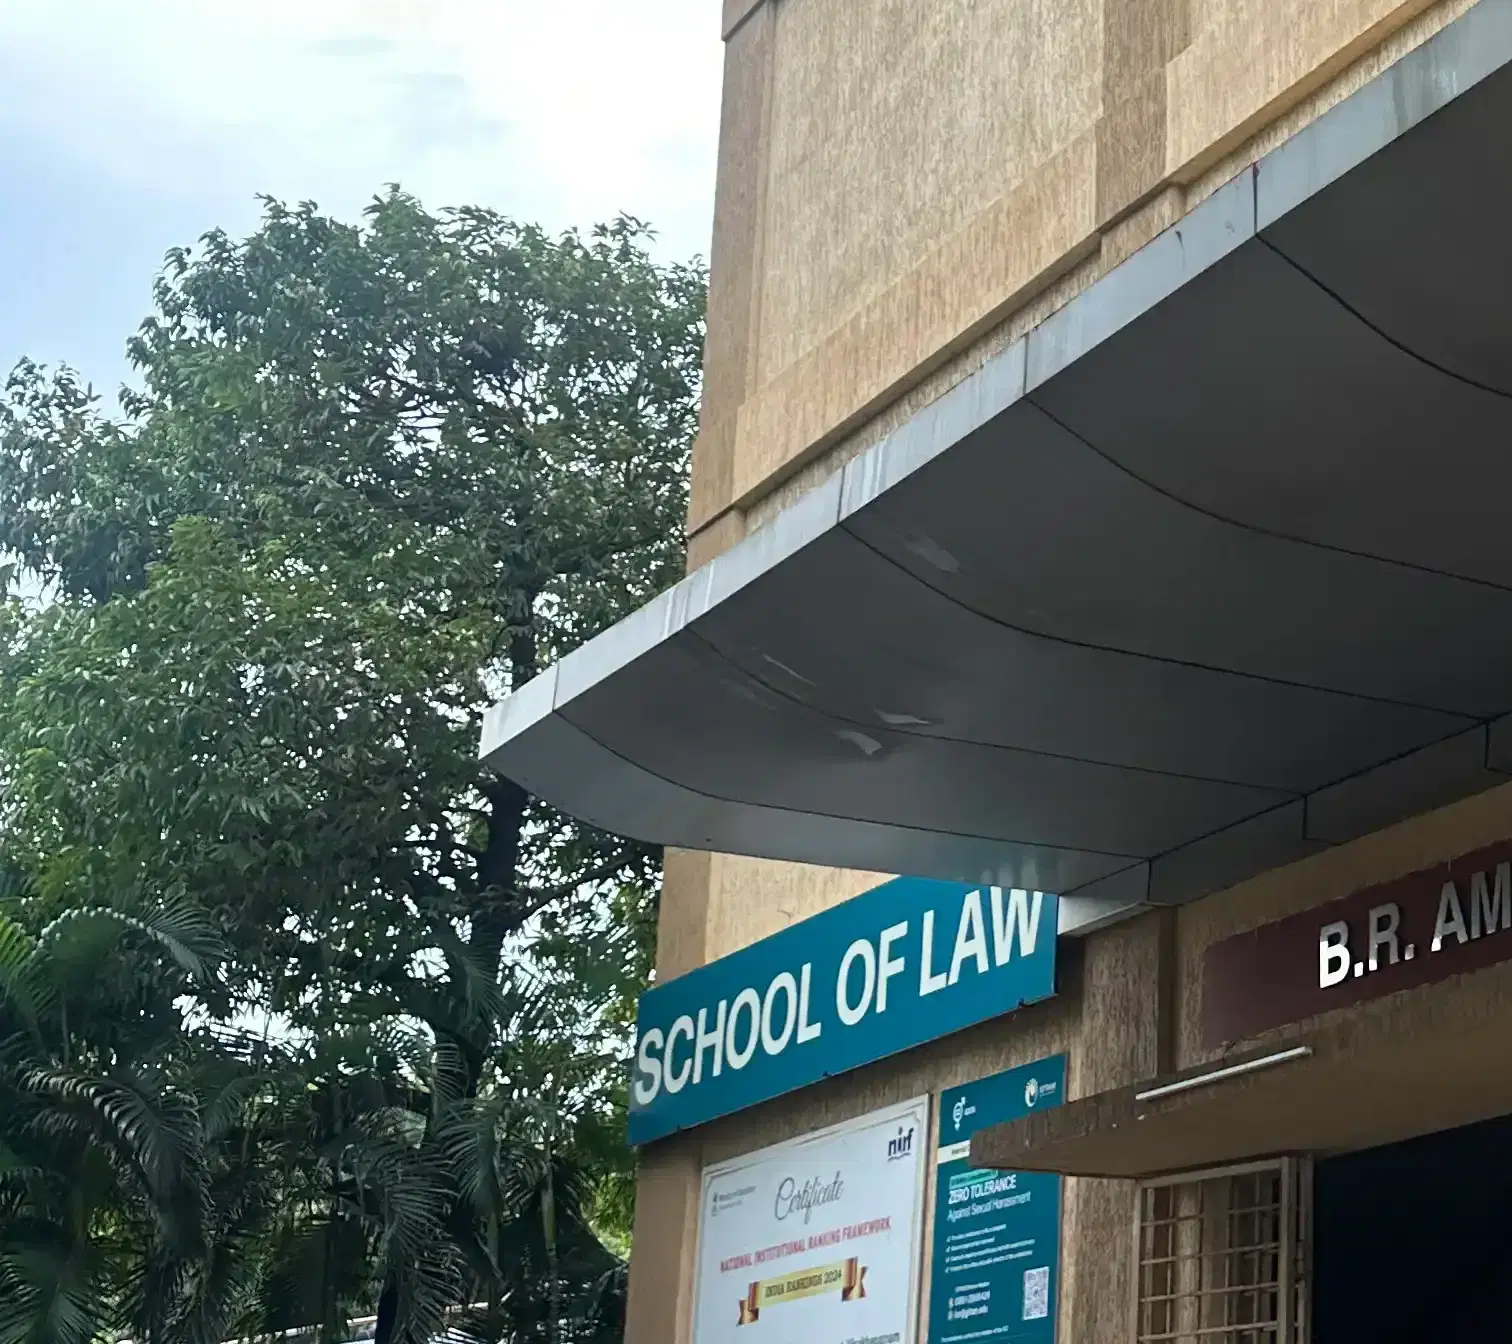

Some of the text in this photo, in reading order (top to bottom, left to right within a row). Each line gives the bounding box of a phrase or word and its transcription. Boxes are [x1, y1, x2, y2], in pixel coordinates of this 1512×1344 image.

[1319, 901, 1416, 989] B.R.
[633, 886, 1043, 1106] SCHOOL OF LAW
[888, 1126, 914, 1157] nirf
[774, 1170, 845, 1225] Certificate
[948, 1188, 970, 1205] ZERO
[970, 1174, 1017, 1199] TOLERANCE
